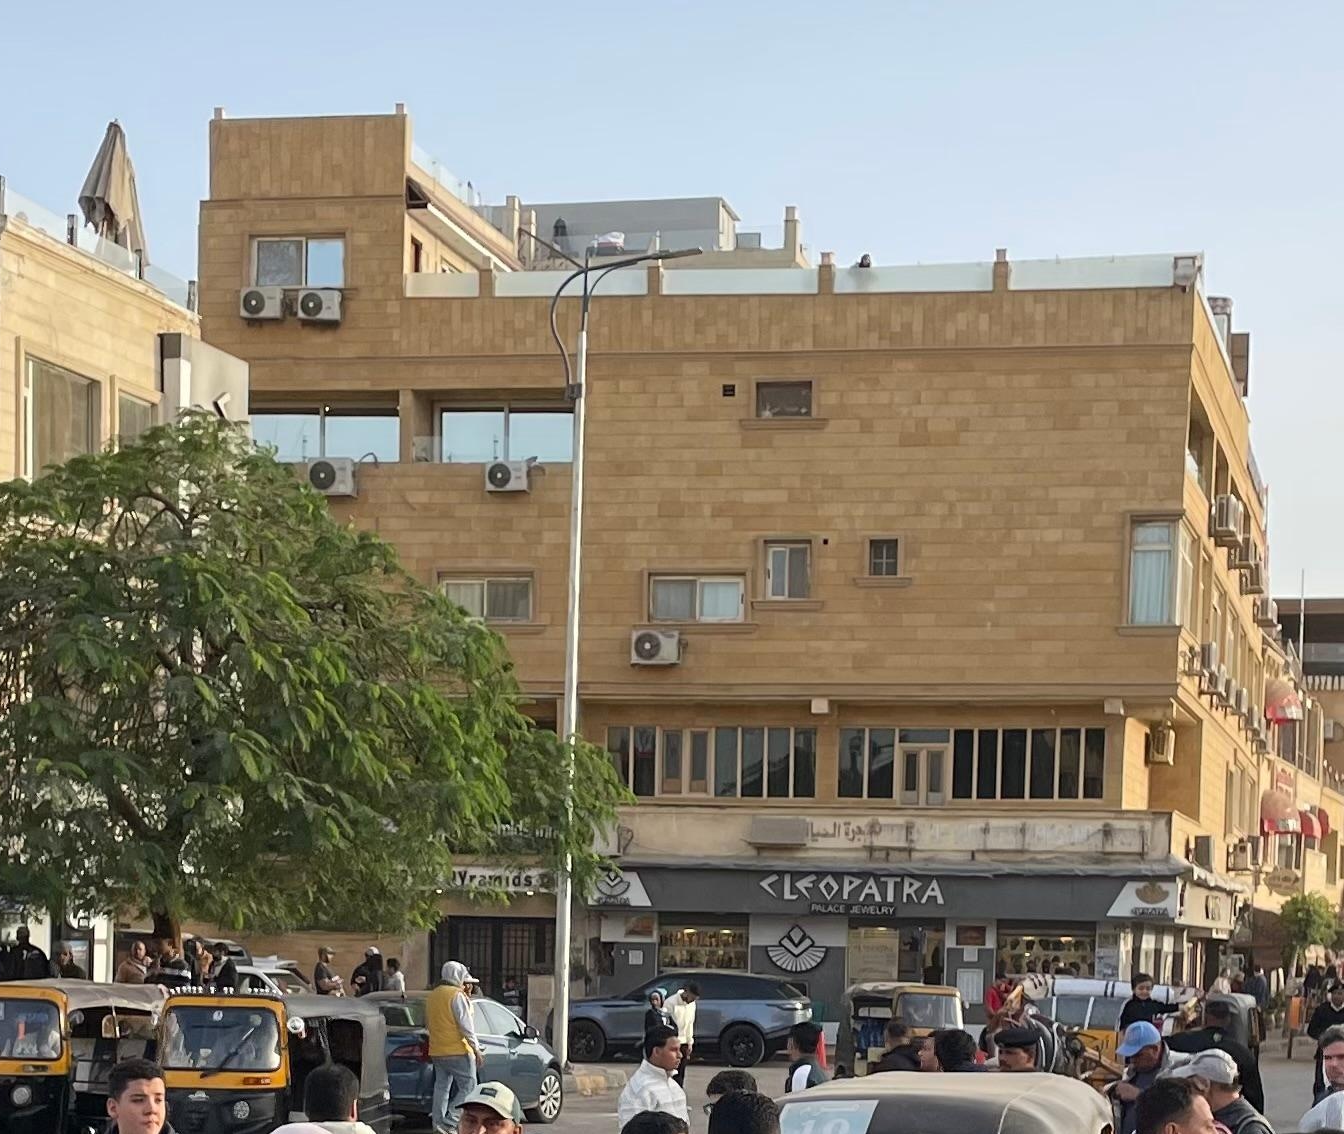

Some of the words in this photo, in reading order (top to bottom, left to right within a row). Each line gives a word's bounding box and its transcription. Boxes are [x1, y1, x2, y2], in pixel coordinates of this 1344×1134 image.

[759, 873, 944, 905] CLEOPATRA
[811, 903, 846, 914] PALACE
[849, 904, 895, 915] JEWELRY
